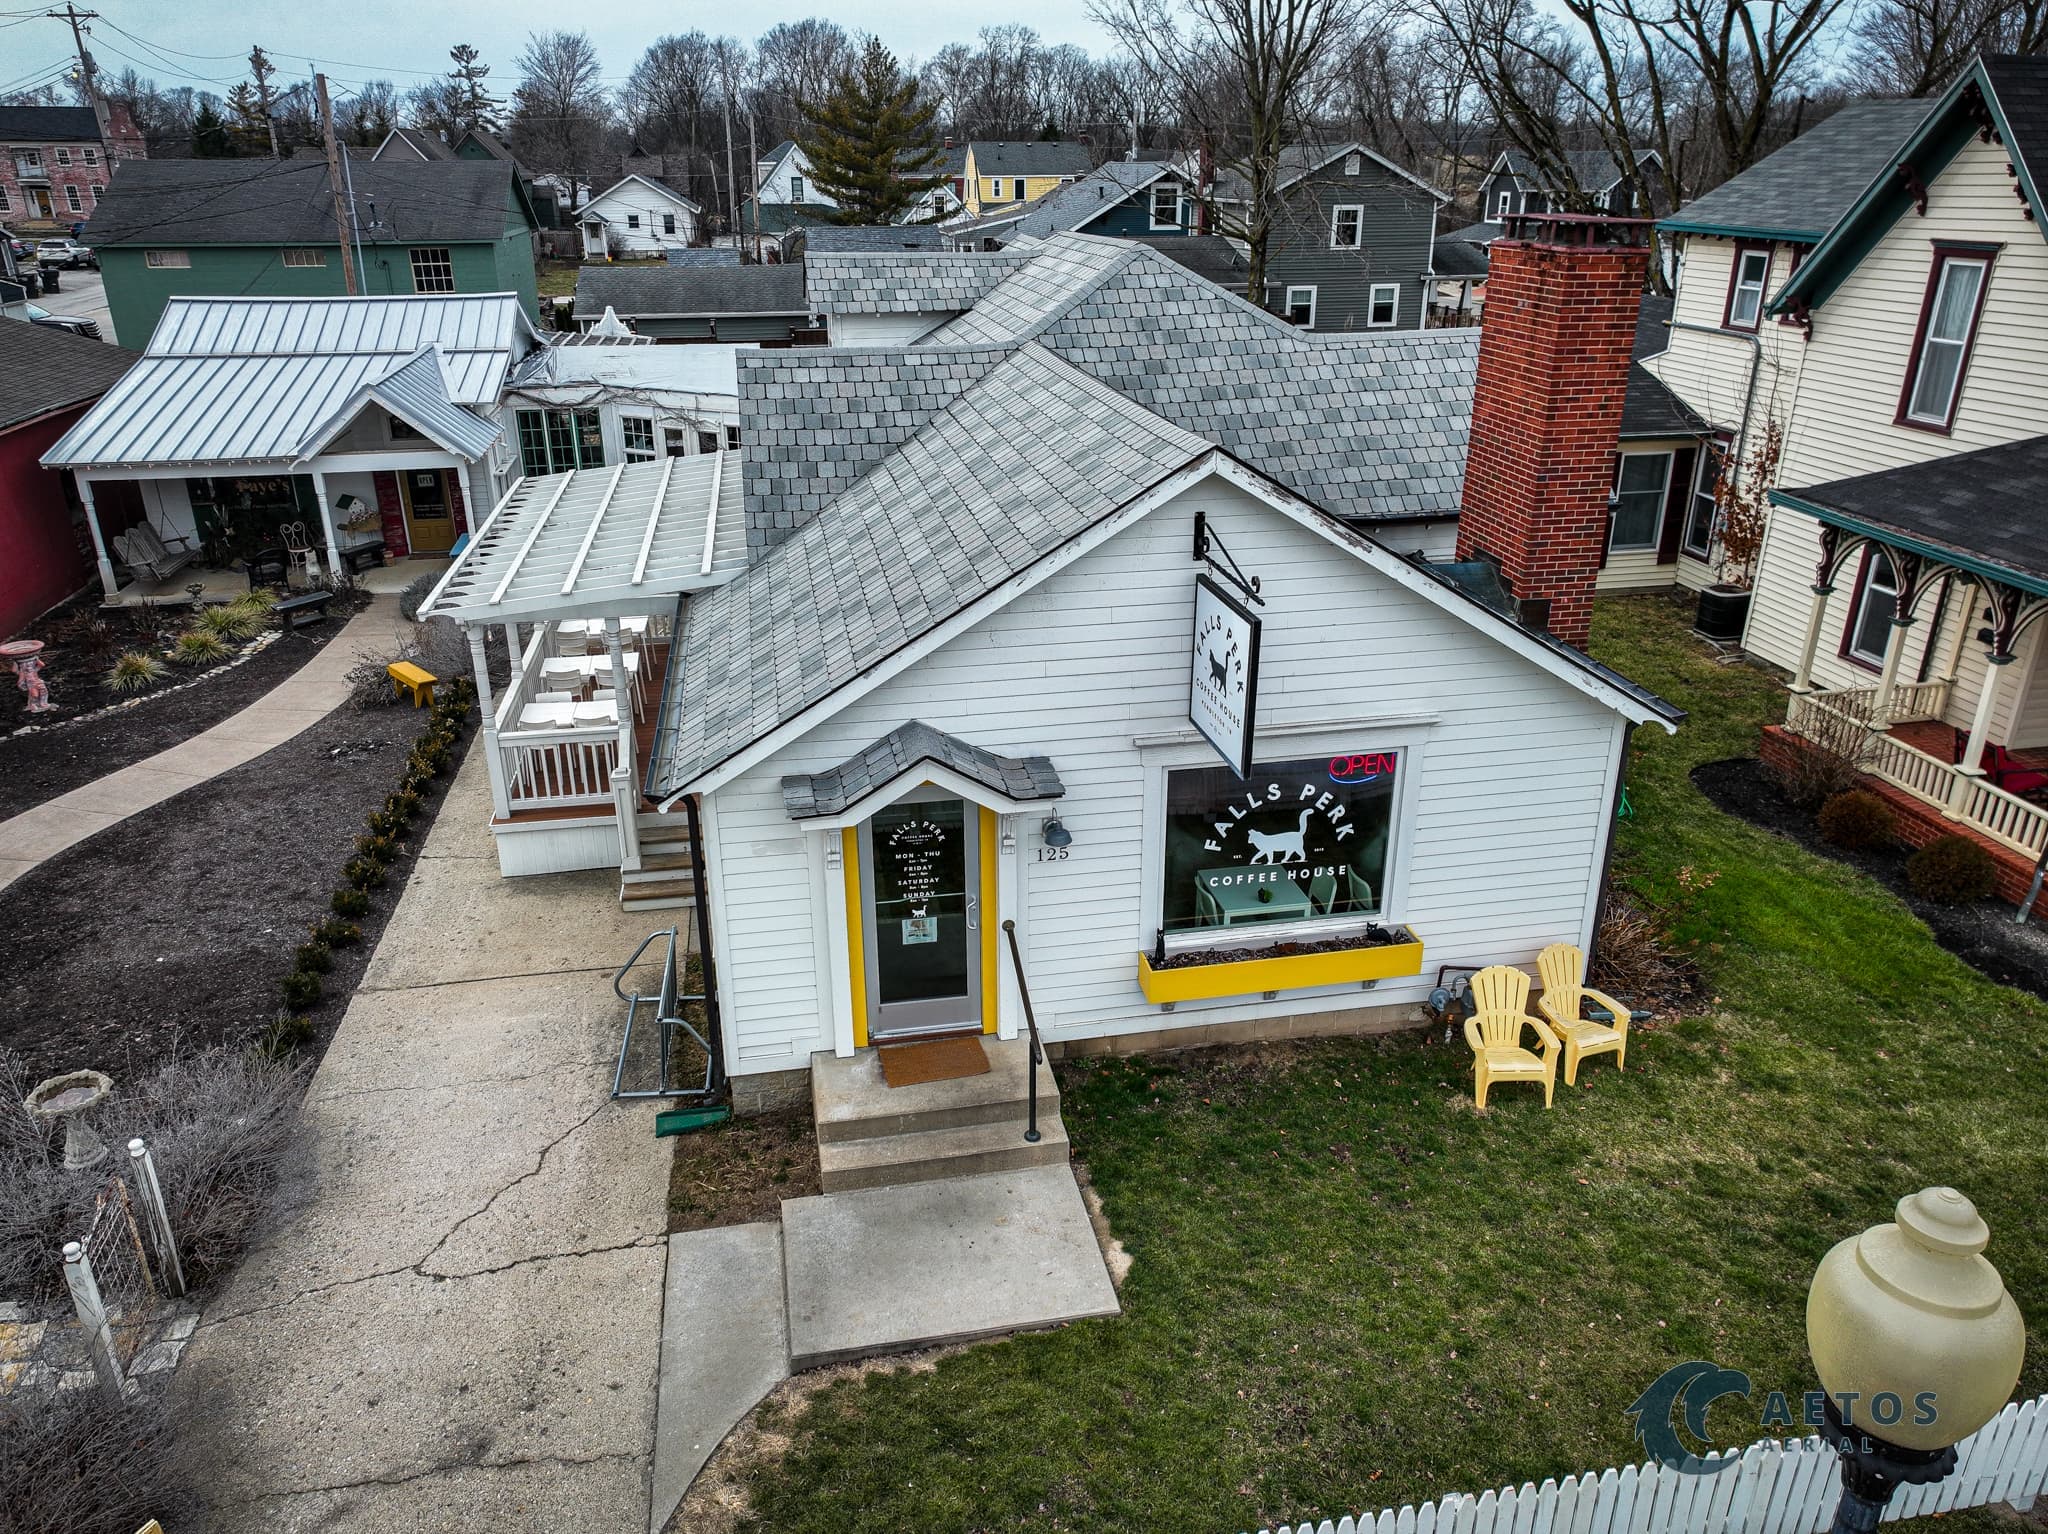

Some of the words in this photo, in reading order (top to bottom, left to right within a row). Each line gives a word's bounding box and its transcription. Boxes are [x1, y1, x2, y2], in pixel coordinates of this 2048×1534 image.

[1196, 615, 1222, 657] FALLS
[1226, 627, 1244, 694] PERK
[1196, 677, 1218, 705] COFFEE
[1219, 701, 1241, 729] HOUSE
[1329, 753, 1396, 777] OPEN
[1204, 783, 1282, 852] FALLS
[1299, 783, 1355, 842] PERK
[889, 820, 917, 846] FALLS
[922, 820, 946, 842] PERK
[1037, 847, 1070, 862] 125
[898, 878, 940, 886] SATURDAY
[1209, 870, 1278, 888] COFFEE
[1287, 864, 1348, 881] HOUSE
